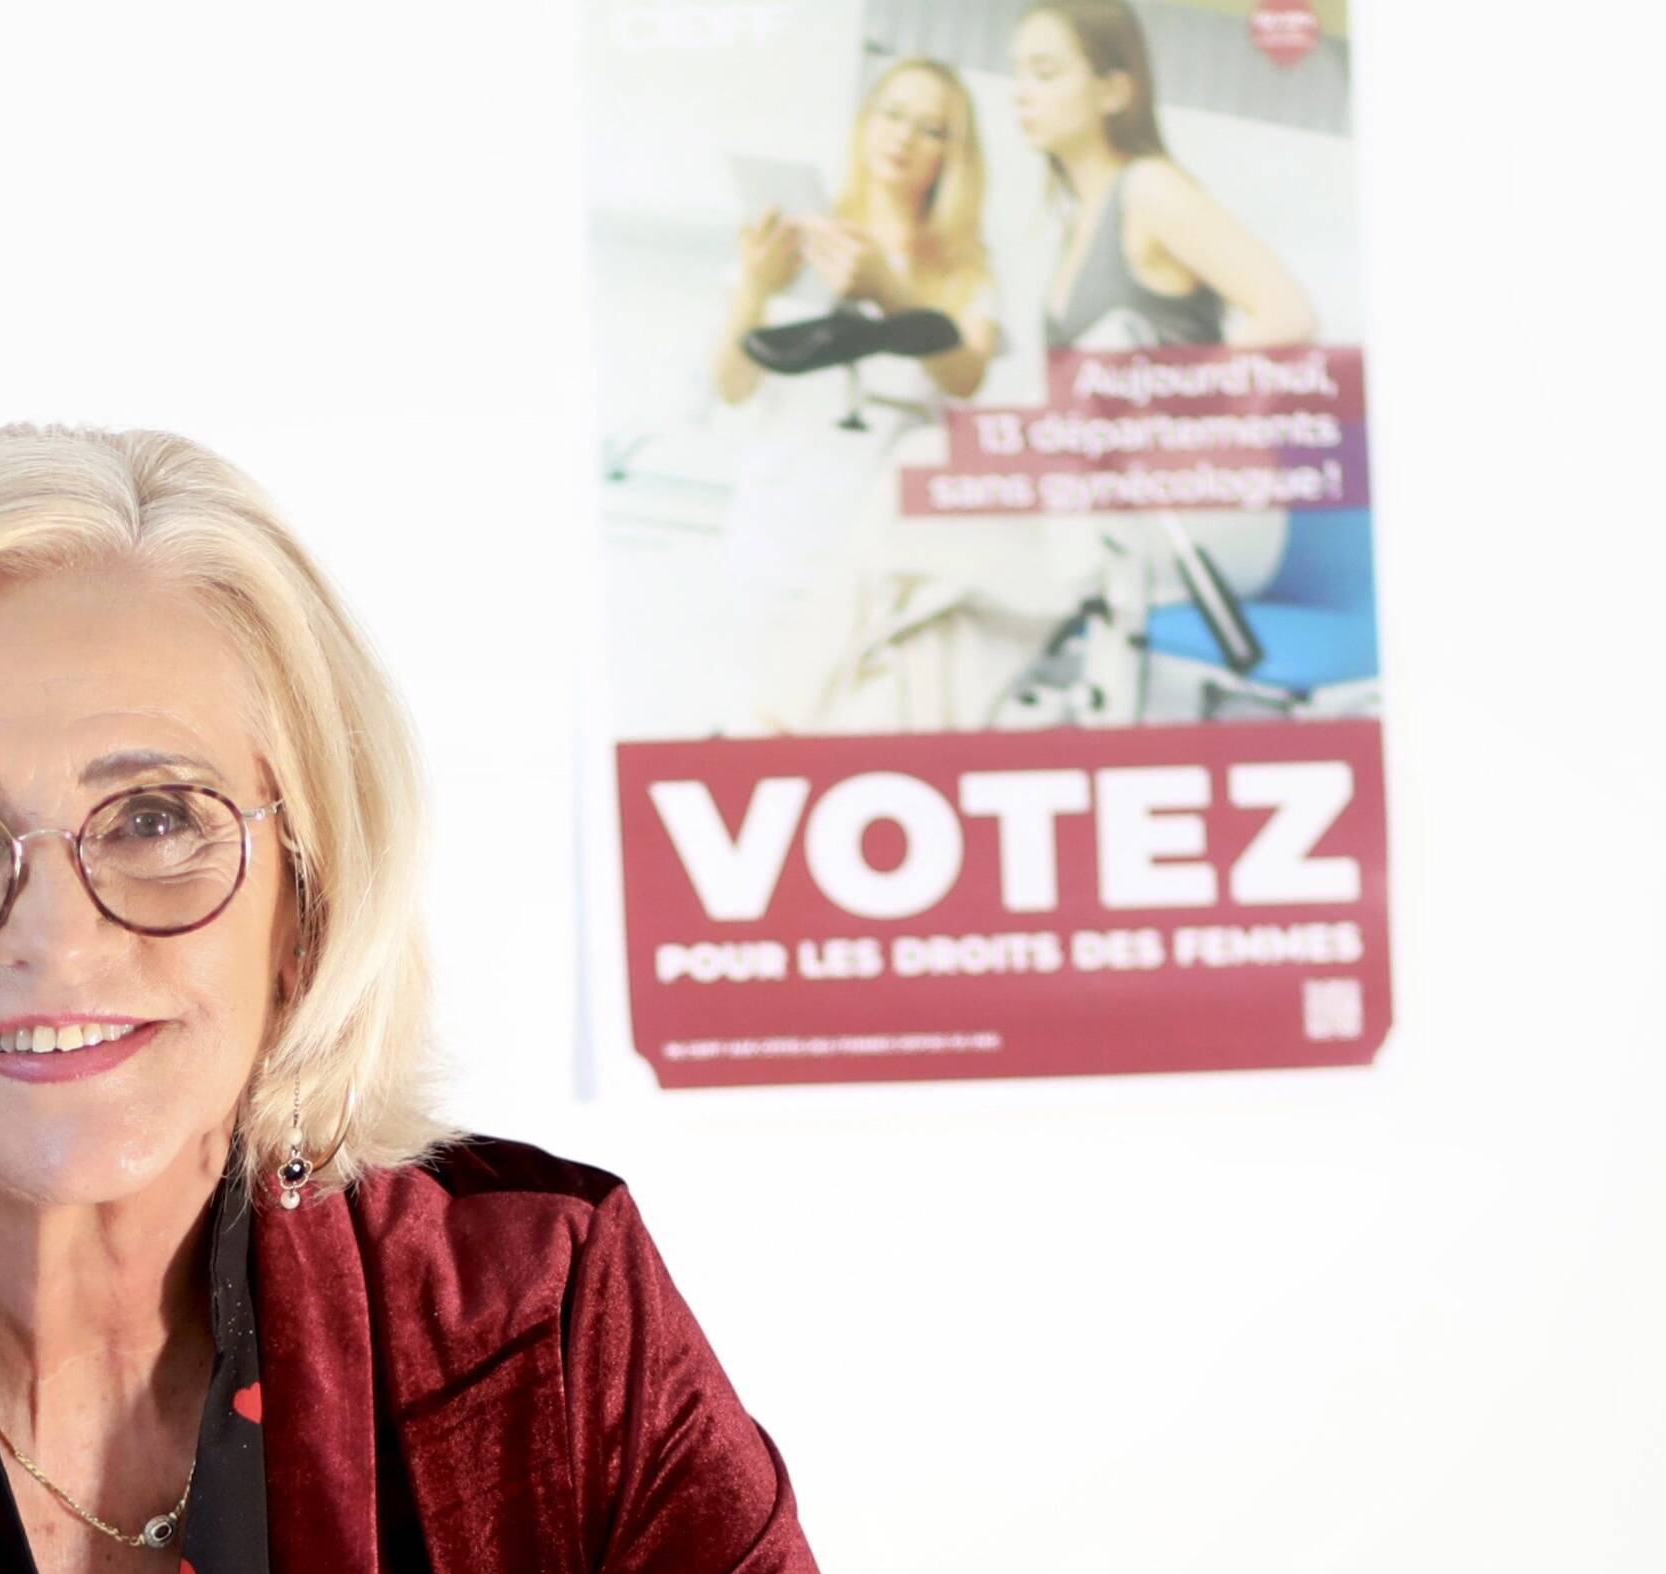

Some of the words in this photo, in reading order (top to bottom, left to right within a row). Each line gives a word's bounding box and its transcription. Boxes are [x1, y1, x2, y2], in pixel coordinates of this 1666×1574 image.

[977, 415, 1022, 453] 13
[1028, 411, 1340, 457] départements
[929, 473, 1033, 508] sans
[650, 762, 1360, 921] VOTEZ
[656, 944, 786, 984] POUR
[800, 938, 881, 978] LES
[894, 932, 1062, 974] DROITS
[1074, 928, 1162, 970] DES
[1175, 923, 1361, 966] FEMMES
